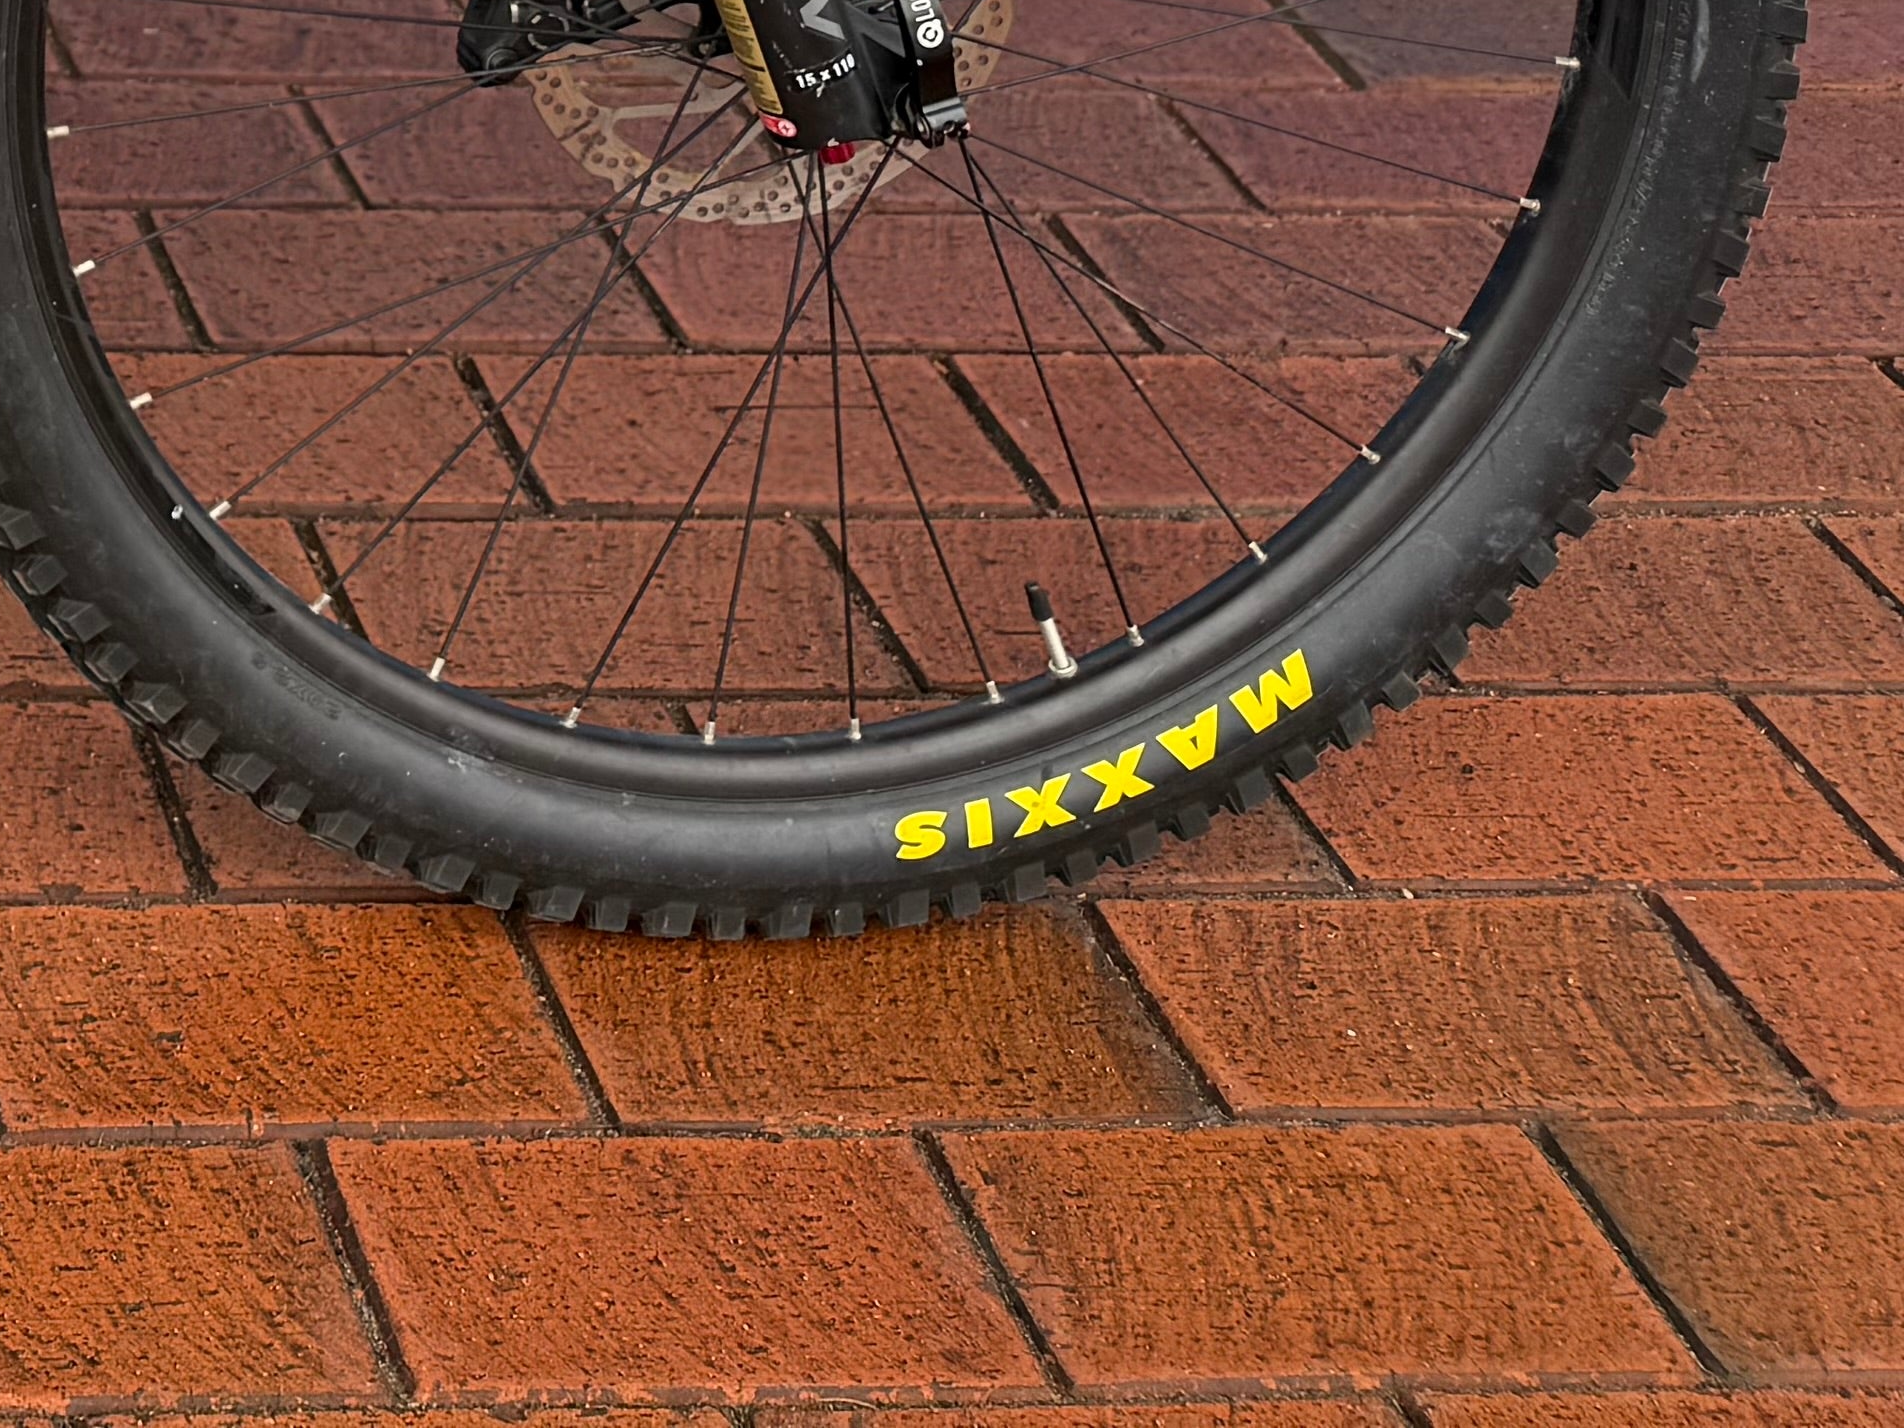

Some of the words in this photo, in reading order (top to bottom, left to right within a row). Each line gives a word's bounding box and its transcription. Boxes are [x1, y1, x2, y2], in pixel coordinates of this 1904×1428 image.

[796, 72, 817, 89] 15
[832, 53, 856, 80] 110
[894, 647, 1316, 861] MAXXIS
